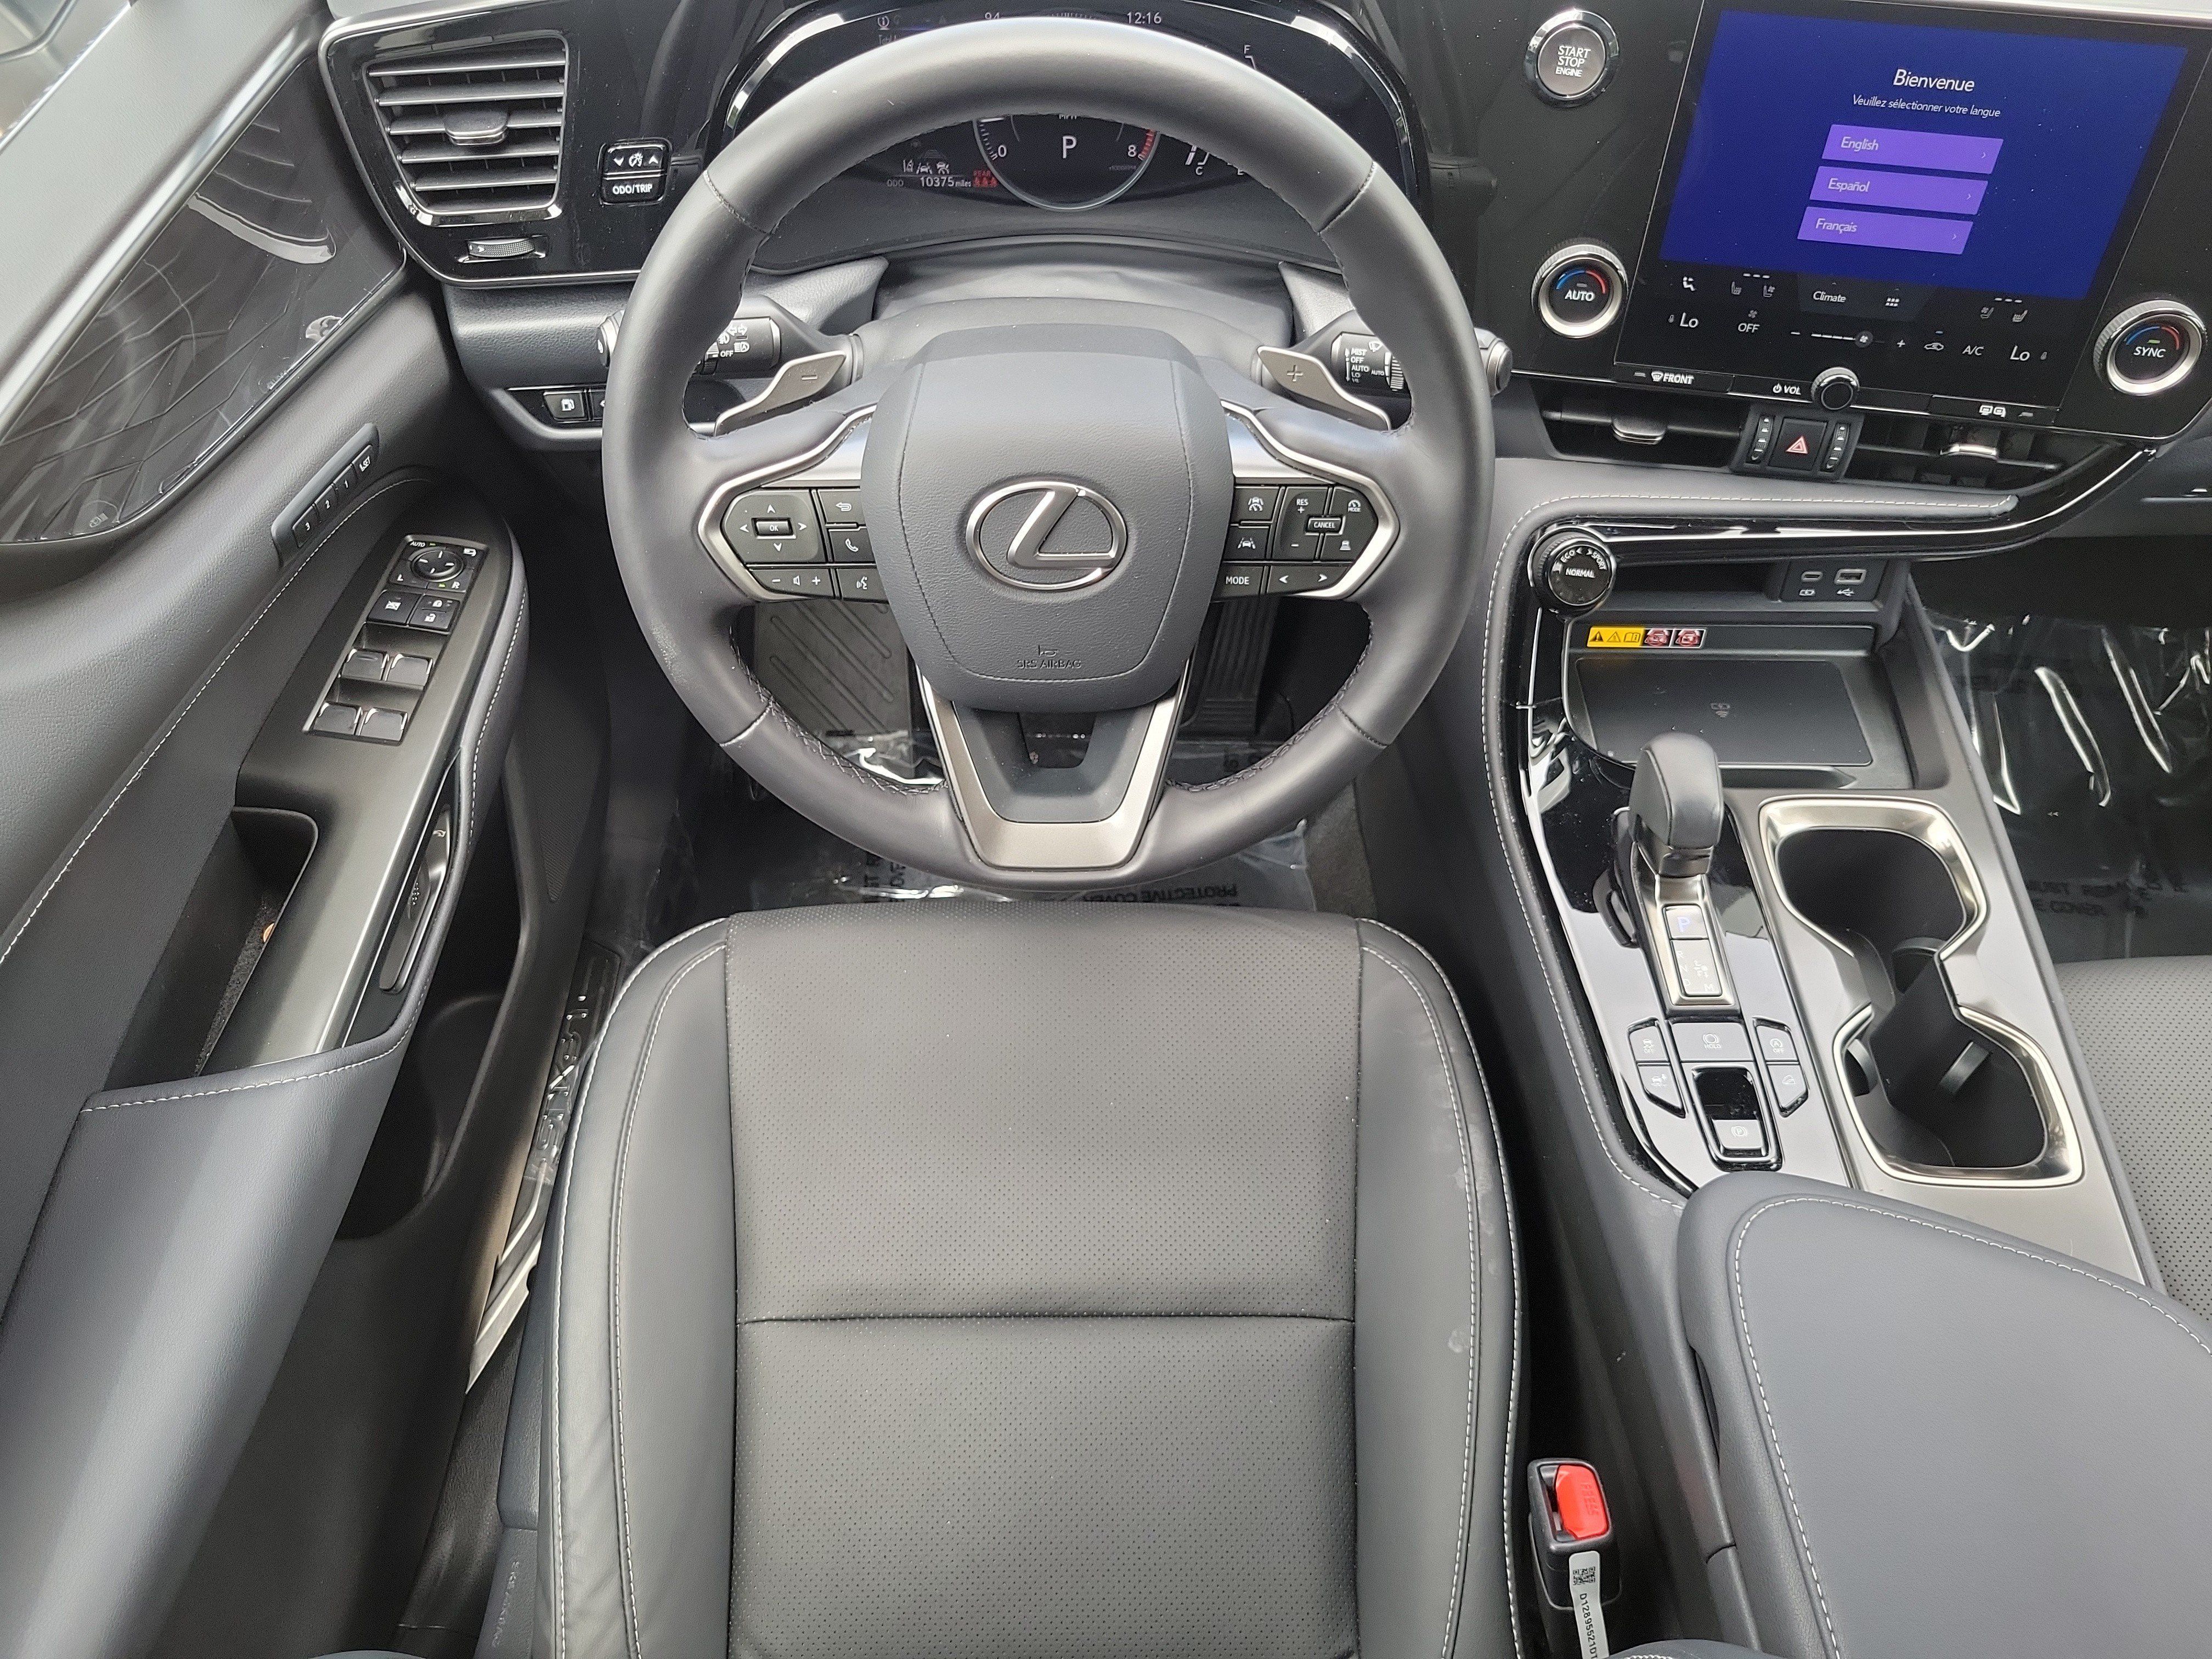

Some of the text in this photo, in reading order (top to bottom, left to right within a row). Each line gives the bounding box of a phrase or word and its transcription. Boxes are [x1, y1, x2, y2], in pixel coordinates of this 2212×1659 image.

[1126, 12, 1162, 25] 12:16
[1244, 44, 1250, 54] F
[1558, 45, 1591, 59] START
[1558, 56, 1585, 68] STOP
[1555, 66, 1583, 77] ENGINE
[1893, 69, 1975, 92] Bienvenue
[1852, 94, 2001, 118] Veuillez sélectionner votre langue
[1062, 135, 1077, 159] P
[1840, 136, 1879, 152] English
[997, 144, 1007, 158] 0
[1127, 144, 1137, 157] 8
[1195, 166, 1203, 176] C
[919, 177, 954, 187] 10375
[955, 179, 972, 188] miles
[1827, 178, 1870, 193] Español
[612, 183, 653, 195] ODO/TRIP
[1815, 217, 1857, 234] Français
[1564, 289, 1595, 302] AUTO
[1813, 291, 1847, 303] Climate
[1680, 312, 1699, 328] Lo
[1737, 323, 1760, 332] OFF
[1351, 347, 1367, 357] MIST
[1962, 345, 1984, 356] A/C
[2010, 346, 2030, 362] Lo
[2133, 346, 2166, 358] SYNC
[1351, 364, 1370, 373] AUTO
[1663, 373, 1694, 385] FRONT
[1784, 386, 1802, 396] VOL
[343, 480, 349, 489] 1
[325, 500, 331, 509] 2
[305, 523, 310, 531] 3
[769, 524, 779, 532] OK
[1560, 549, 1576, 563] ECO
[1591, 551, 1607, 571] SPORT
[397, 574, 404, 582] L
[1565, 567, 1595, 578] NORMAL
[452, 581, 461, 589] R
[1225, 576, 1250, 585] MODE
[1017, 659, 1082, 669] SRS AIRBAG
[1677, 916, 1691, 933] P
[1703, 983, 1715, 992] M
